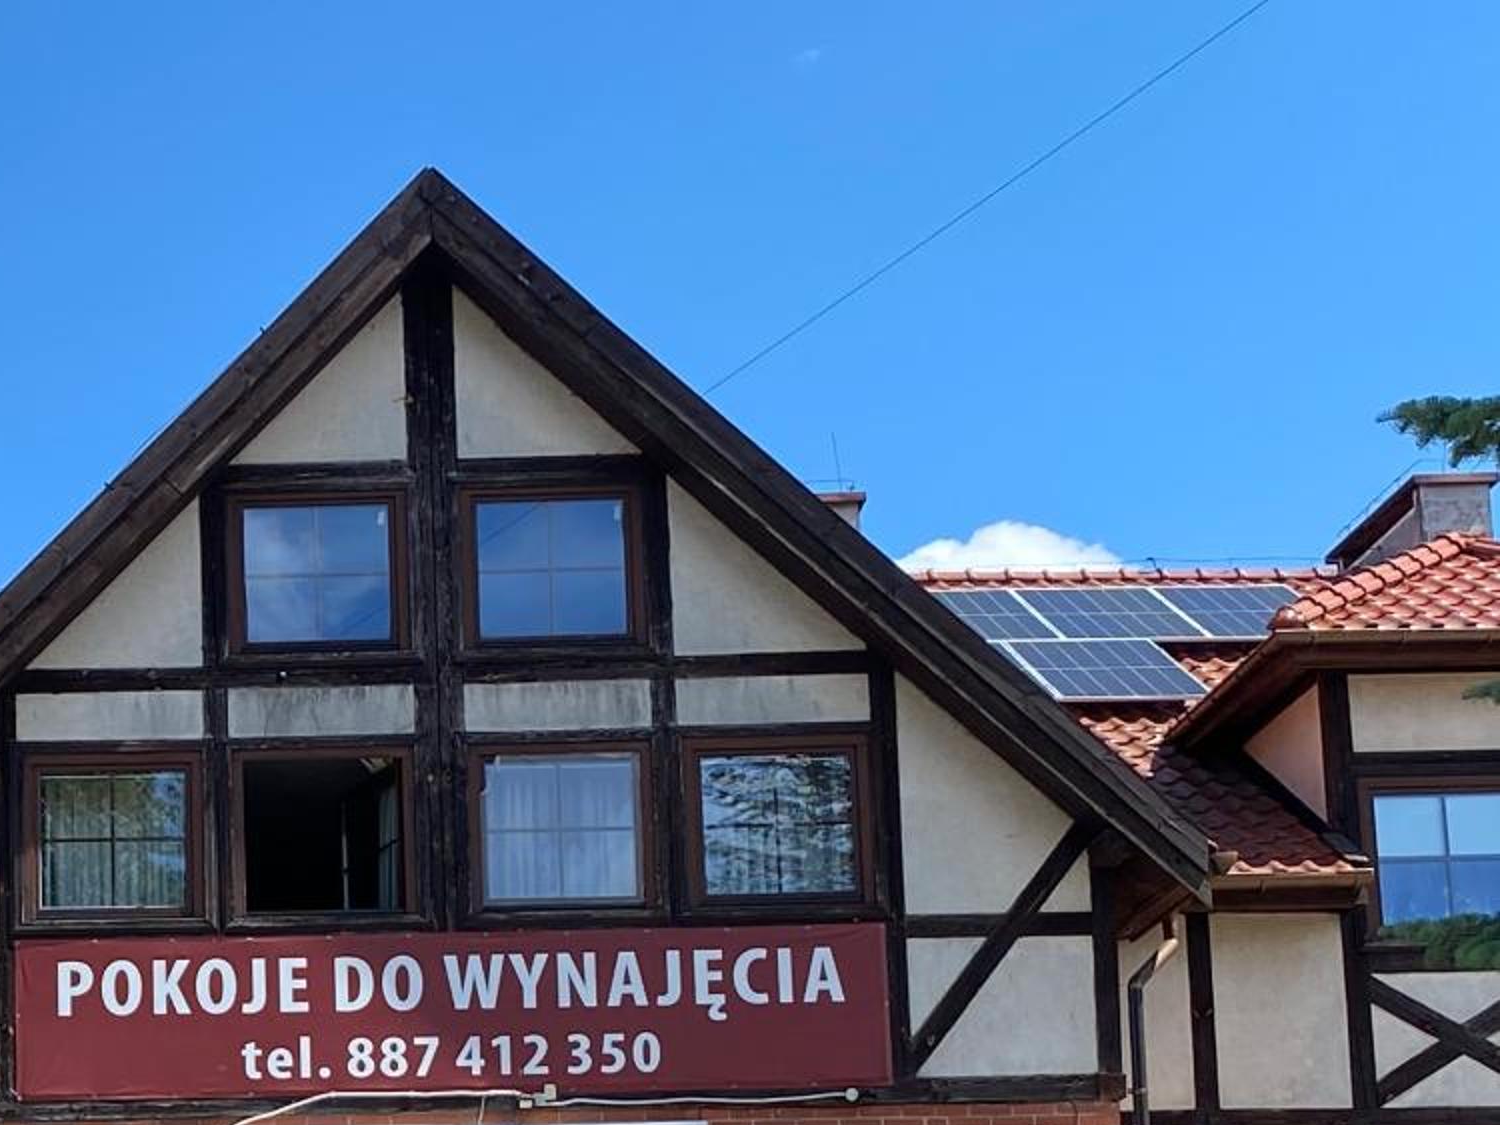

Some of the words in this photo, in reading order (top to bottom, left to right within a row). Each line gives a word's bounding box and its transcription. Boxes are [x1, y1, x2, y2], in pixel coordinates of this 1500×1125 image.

[57, 957, 310, 1017] POKOJE
[334, 955, 423, 1013] DO
[443, 946, 846, 1021] WYNAJĘCIA
[240, 1035, 331, 1080] tel.
[347, 1036, 439, 1079] 887
[455, 1034, 549, 1076] 412
[567, 1032, 661, 1074] 350
